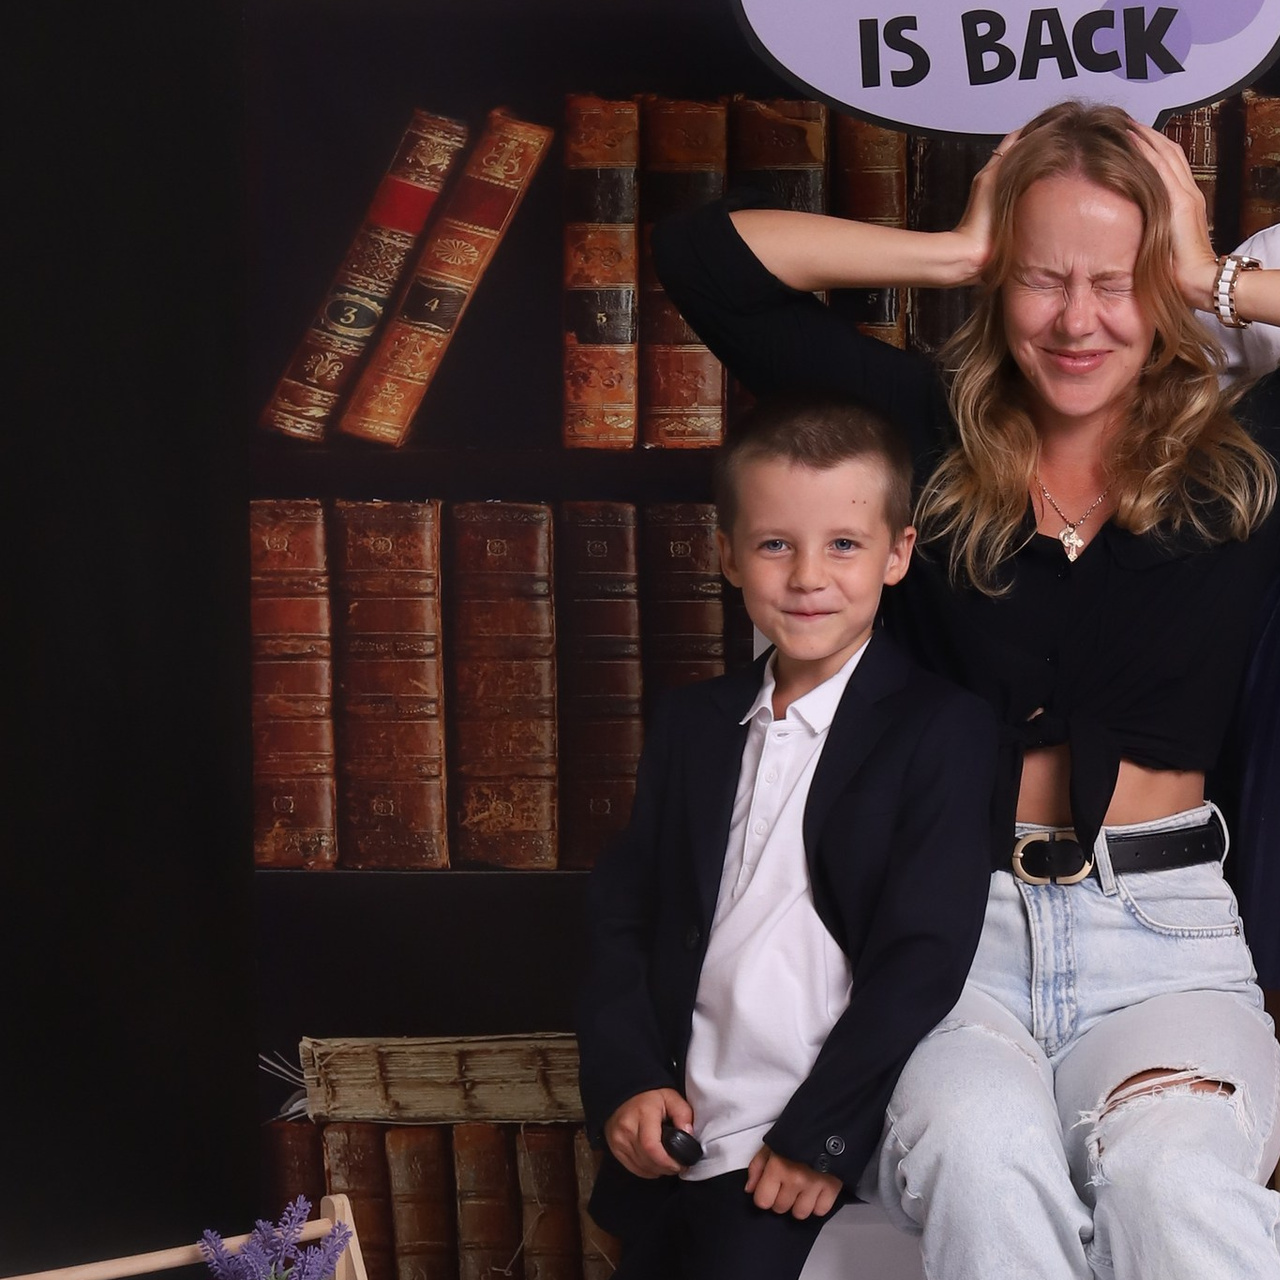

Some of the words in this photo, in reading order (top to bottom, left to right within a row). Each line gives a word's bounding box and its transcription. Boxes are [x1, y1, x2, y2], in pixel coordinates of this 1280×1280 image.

[859, 16, 931, 89] IS
[961, 7, 1186, 86] BACK
[423, 296, 441, 312] 4
[339, 306, 359, 324] 3
